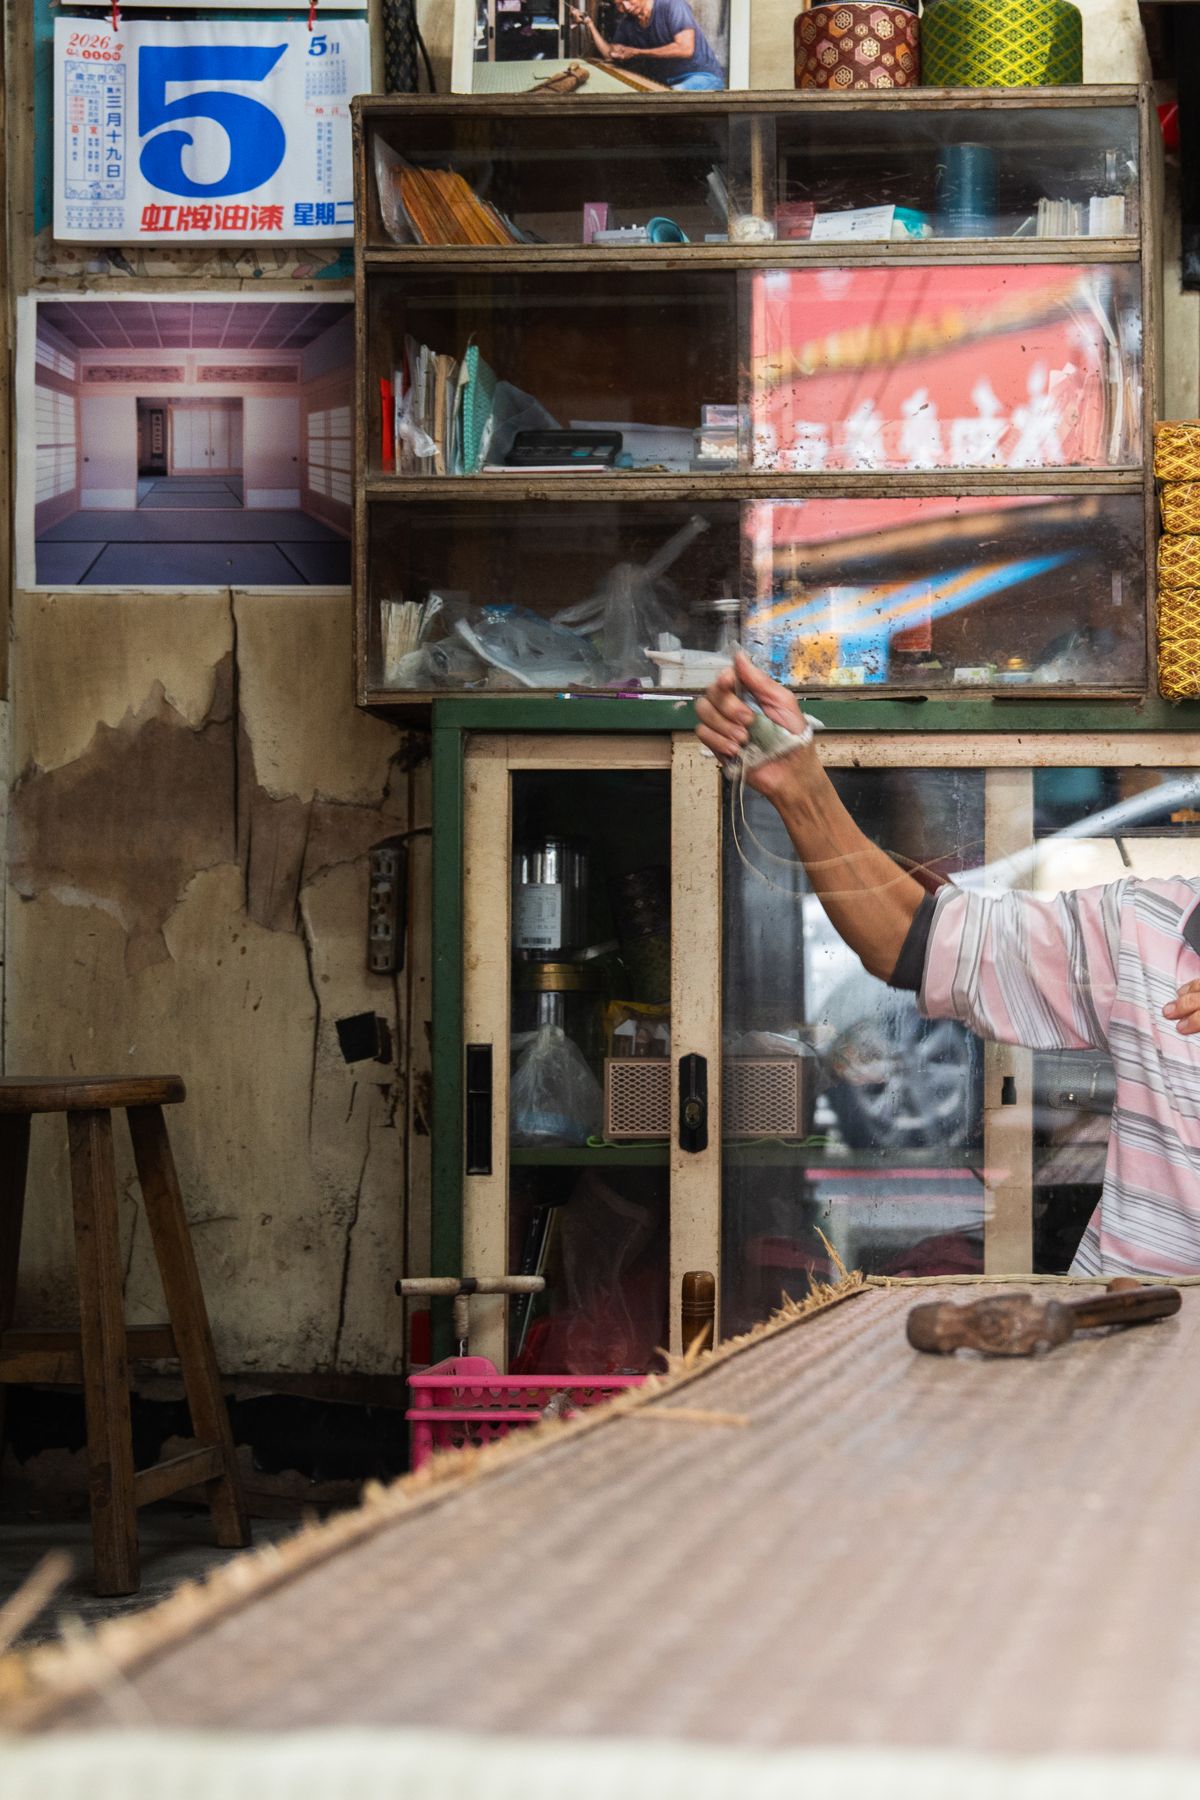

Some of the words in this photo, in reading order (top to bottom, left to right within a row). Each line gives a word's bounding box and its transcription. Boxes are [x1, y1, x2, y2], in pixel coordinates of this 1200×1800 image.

[68, 33, 111, 49] 2026
[138, 43, 289, 199] 5
[106, 95, 122, 178] 三月十九日
[140, 203, 285, 232] 虹牌油漆
[294, 201, 354, 227] 星期二
